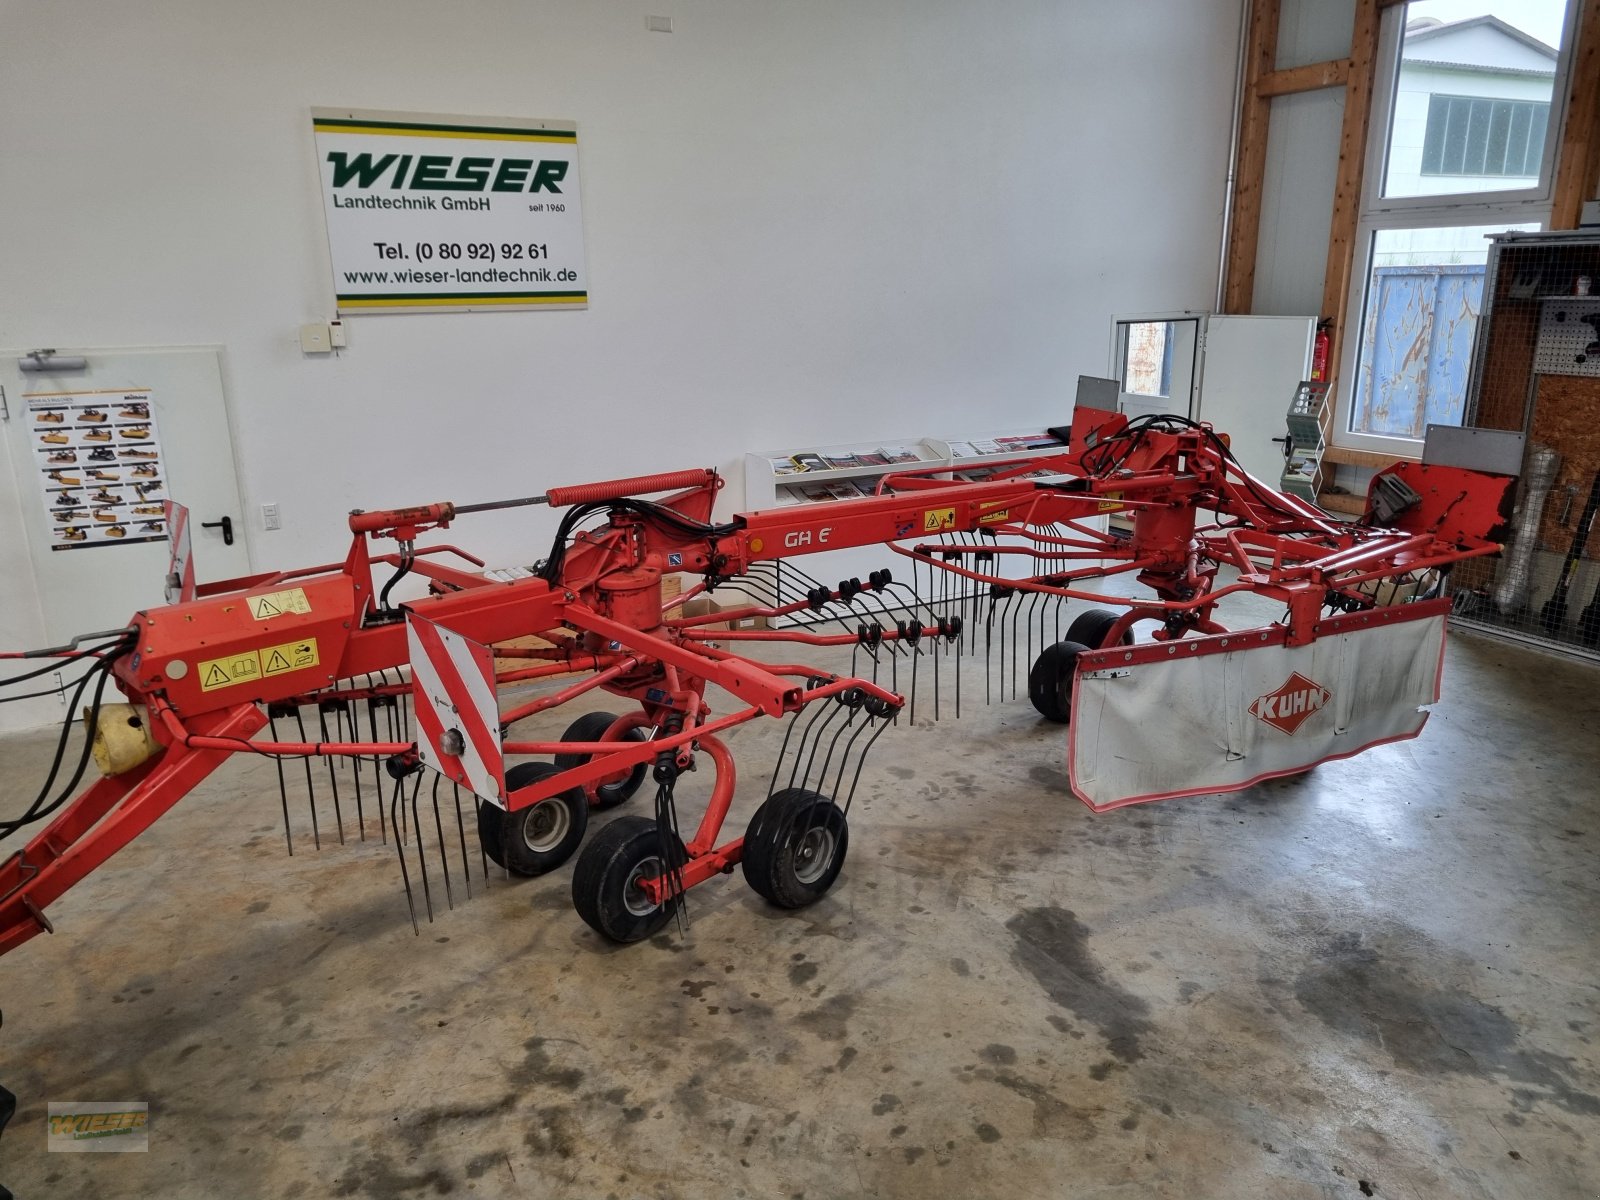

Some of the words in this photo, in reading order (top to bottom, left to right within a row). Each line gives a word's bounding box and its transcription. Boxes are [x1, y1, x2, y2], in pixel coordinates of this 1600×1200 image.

[327, 151, 569, 194] WIESER
[333, 194, 437, 211] Landtechnik
[442, 197, 491, 211] GmbH
[529, 204, 544, 212] seit
[546, 204, 566, 213] 1960
[374, 243, 409, 260] Tel.
[415, 243, 434, 263] (0
[439, 243, 462, 260] 80
[466, 243, 496, 263] 92)
[501, 243, 523, 260] 92
[528, 243, 549, 260] 61
[344, 268, 578, 284] www.wieser-landtechnik.de
[1257, 687, 1326, 720] KUHN
